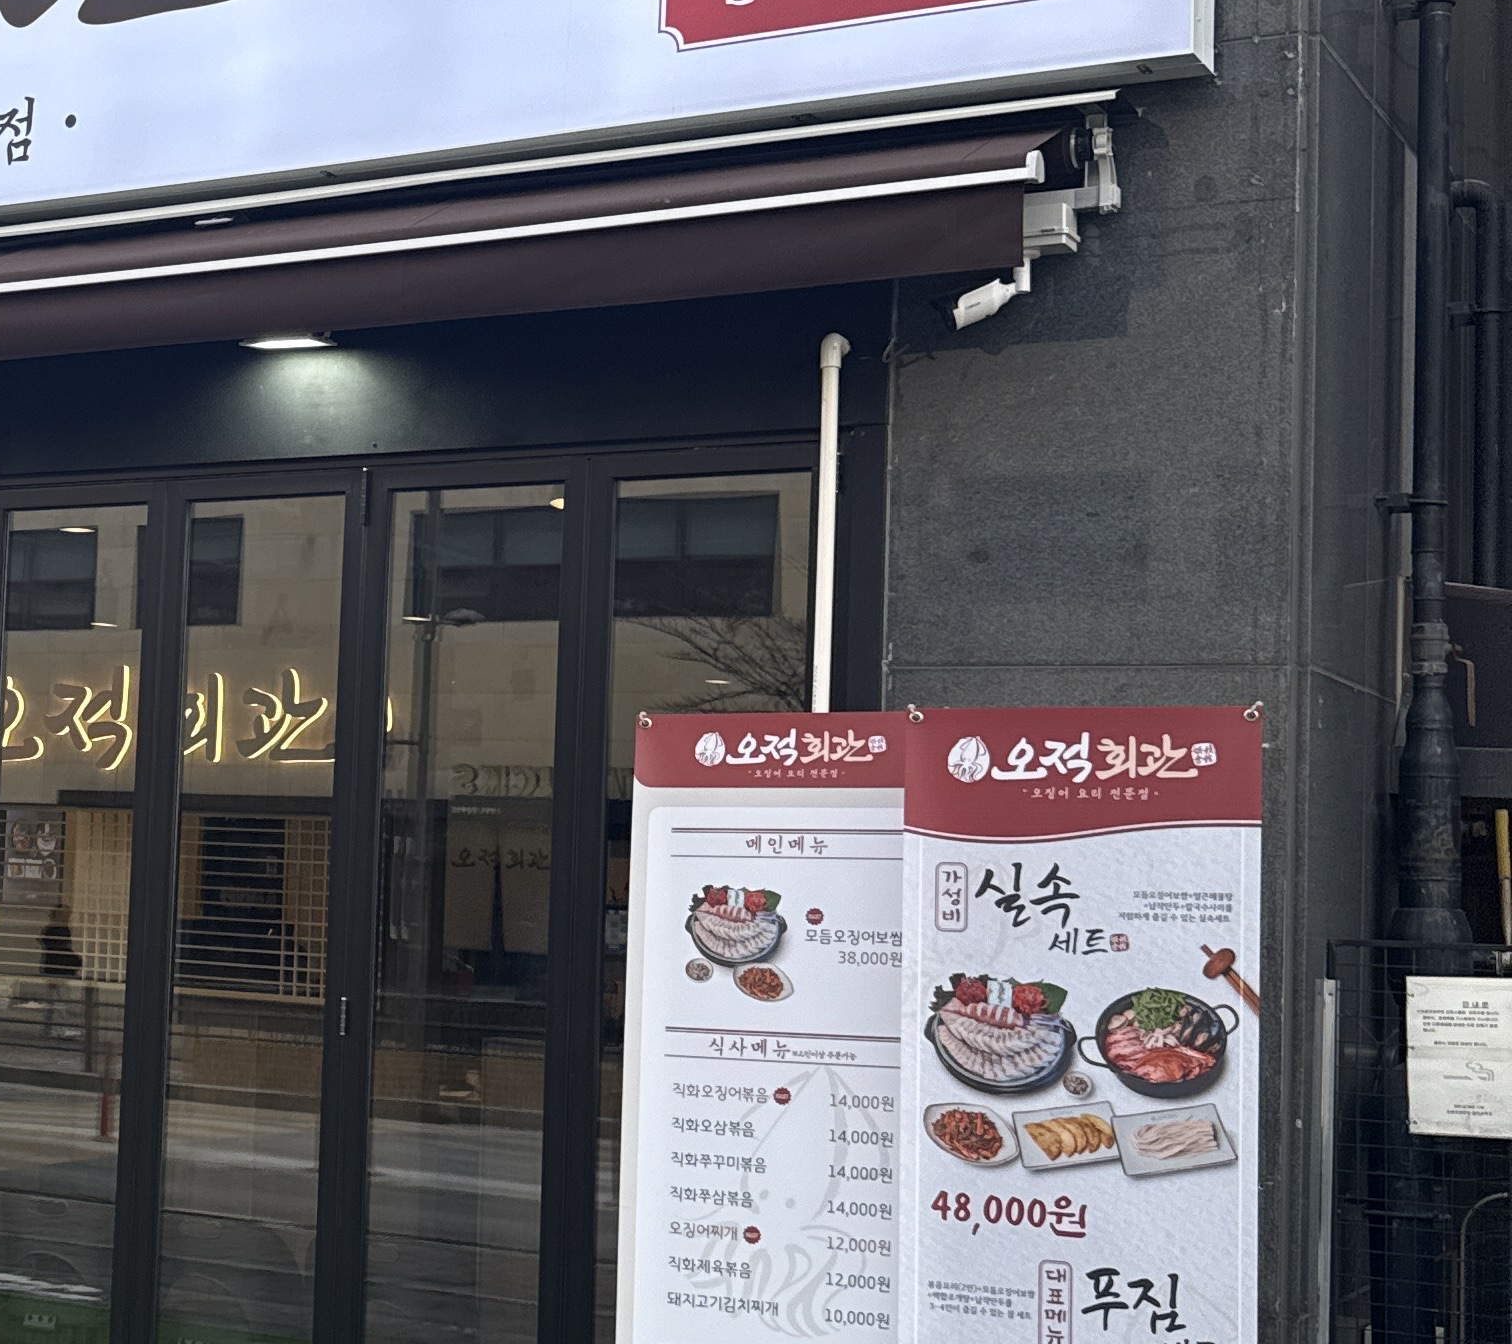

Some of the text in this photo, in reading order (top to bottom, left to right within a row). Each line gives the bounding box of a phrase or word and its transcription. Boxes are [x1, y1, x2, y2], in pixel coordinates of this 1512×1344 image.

[725, 728, 874, 766] 오적회관
[991, 732, 1199, 783] 오적회관
[1031, 787, 1069, 799] 오징어
[1077, 787, 1102, 799] 요리
[745, 835, 829, 855] 메인메뉴
[941, 861, 1080, 928] 가성비 실속
[1048, 927, 1109, 956] 세트
[709, 1036, 791, 1059] 식사메뉴
[672, 1082, 895, 1112] 직화오징어볶음 14,000원
[671, 1117, 894, 1148] 직화오삼볶음 14,000원
[670, 1151, 893, 1184] 직화쭈꾸미볶음 14,000원
[669, 1186, 892, 1220] 직화쭈삼볶음 14,000원
[931, 1190, 1088, 1239] 48,000원
[669, 1221, 891, 1256] 오징어찌개 12,000원
[668, 1256, 890, 1293] 직화제육볶음 12,000원
[667, 1291, 890, 1329] 돼지고기김치찌개 10,000원
[1081, 1266, 1187, 1334] 푸짐
